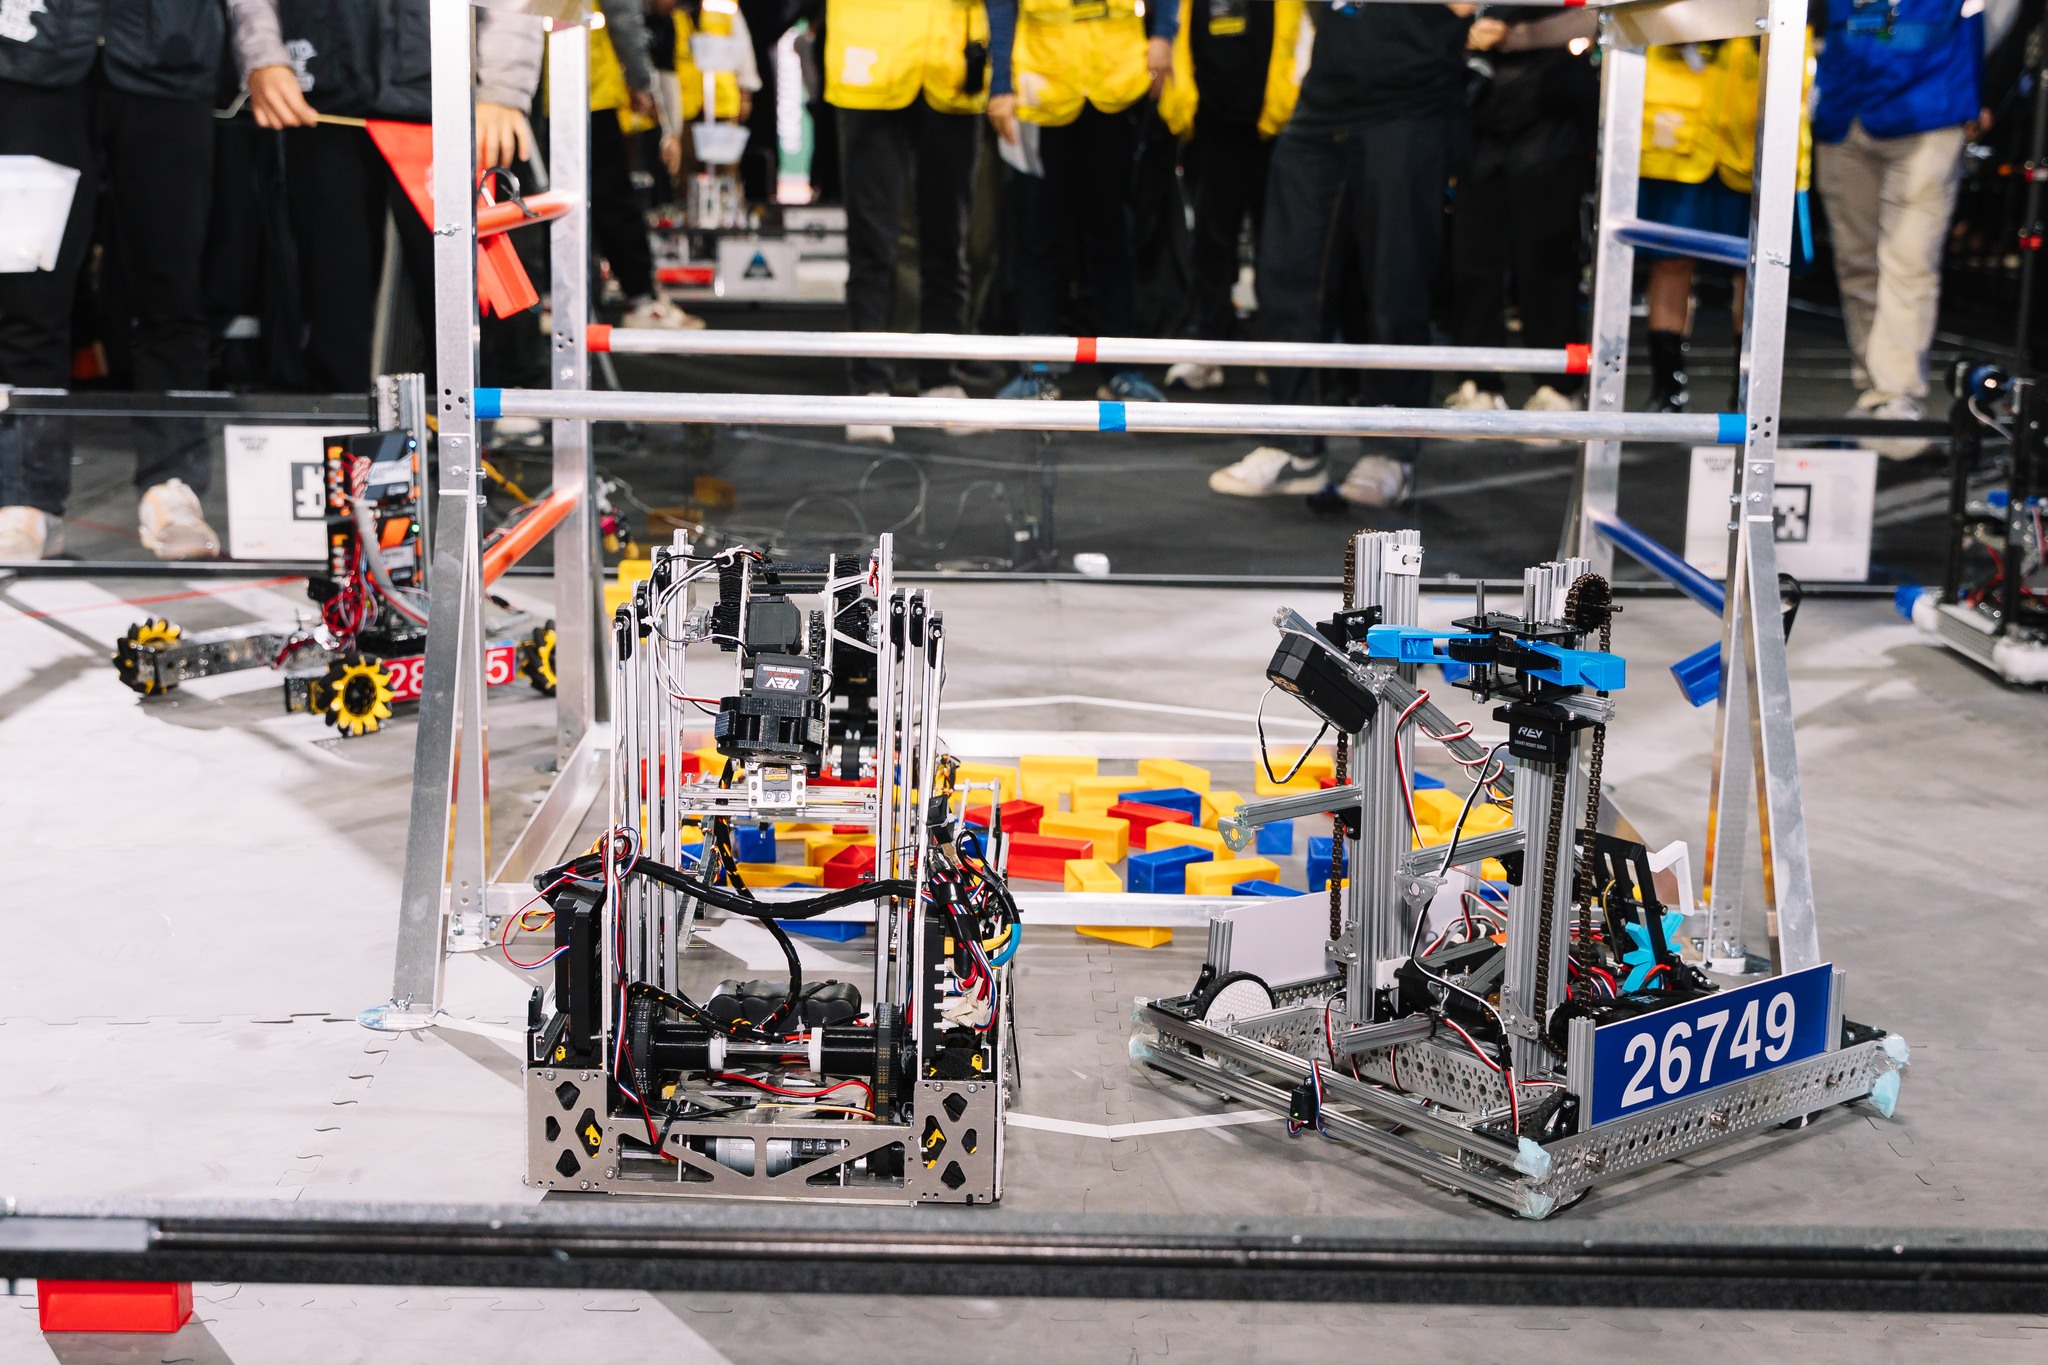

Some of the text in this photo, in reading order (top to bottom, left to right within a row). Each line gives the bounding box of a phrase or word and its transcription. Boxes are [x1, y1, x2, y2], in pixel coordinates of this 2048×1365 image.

[765, 677, 800, 690] REV
[1517, 726, 1544, 739] REV
[1621, 991, 1798, 1109] 26749
